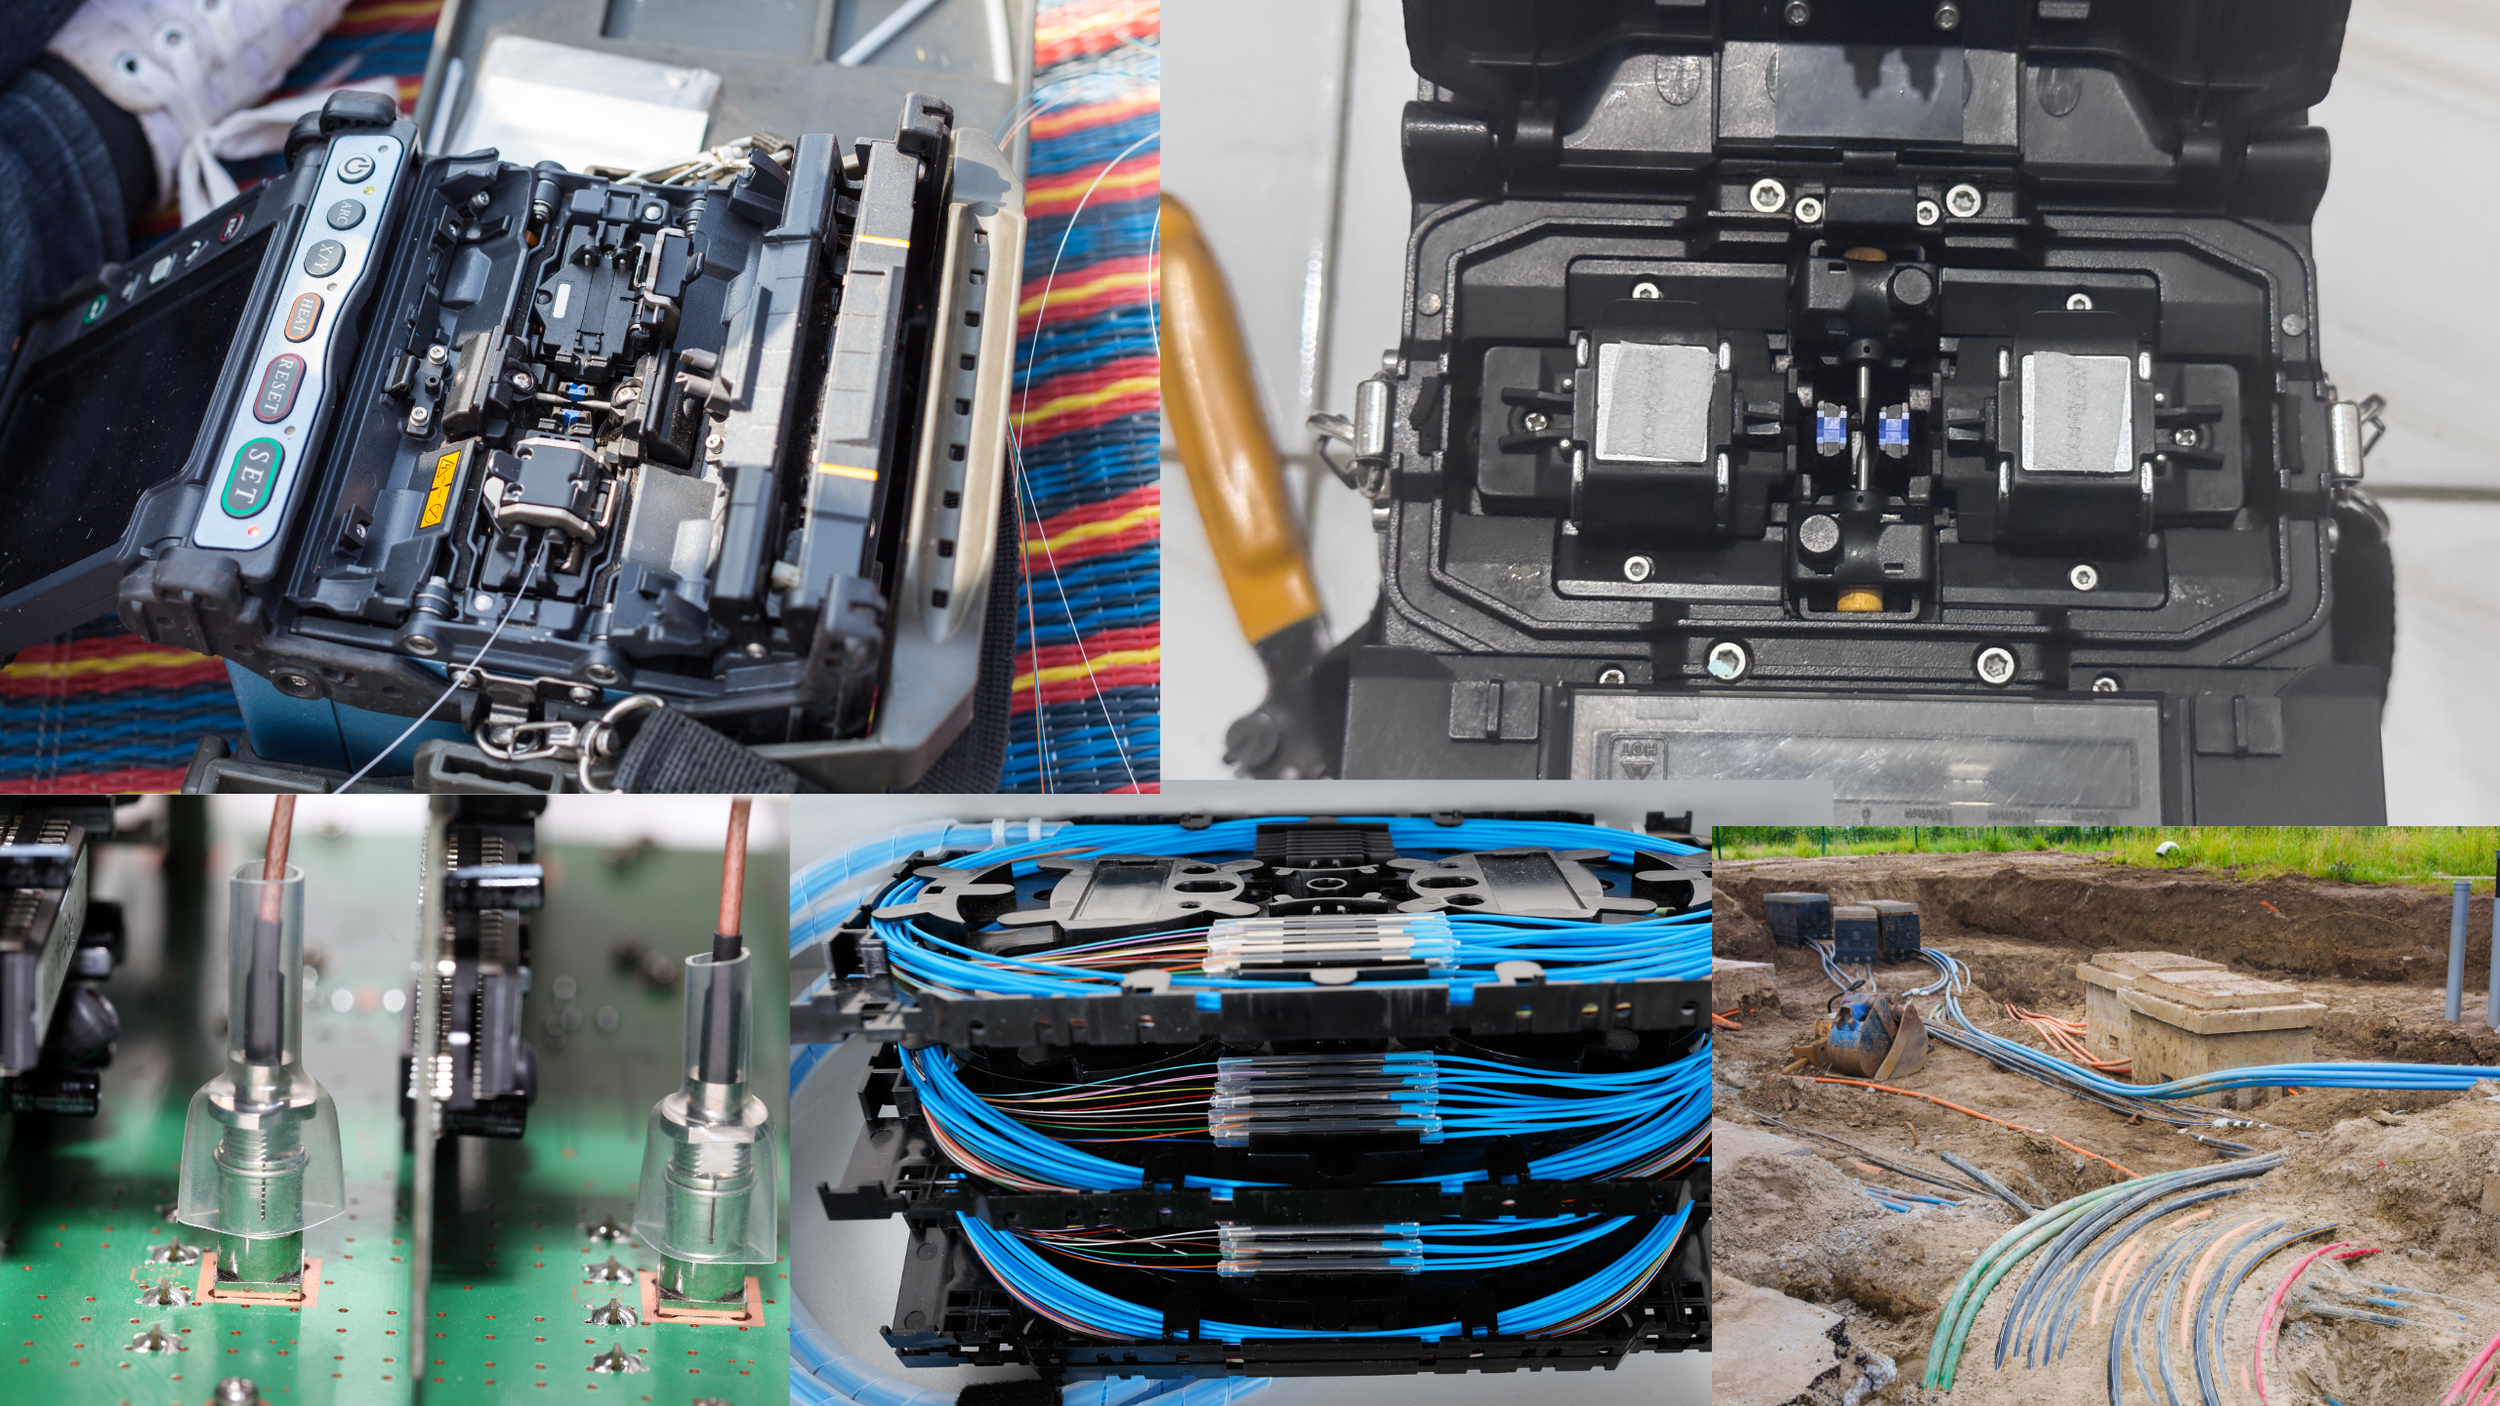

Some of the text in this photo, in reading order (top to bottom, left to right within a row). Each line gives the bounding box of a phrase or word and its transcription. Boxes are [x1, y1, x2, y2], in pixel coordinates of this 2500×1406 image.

[336, 201, 353, 225] ARC
[314, 243, 335, 271] X/Y
[292, 298, 315, 334] HEAT
[264, 358, 295, 414] RESET
[234, 448, 270, 505] SET
[1620, 742, 1658, 757] HOT
